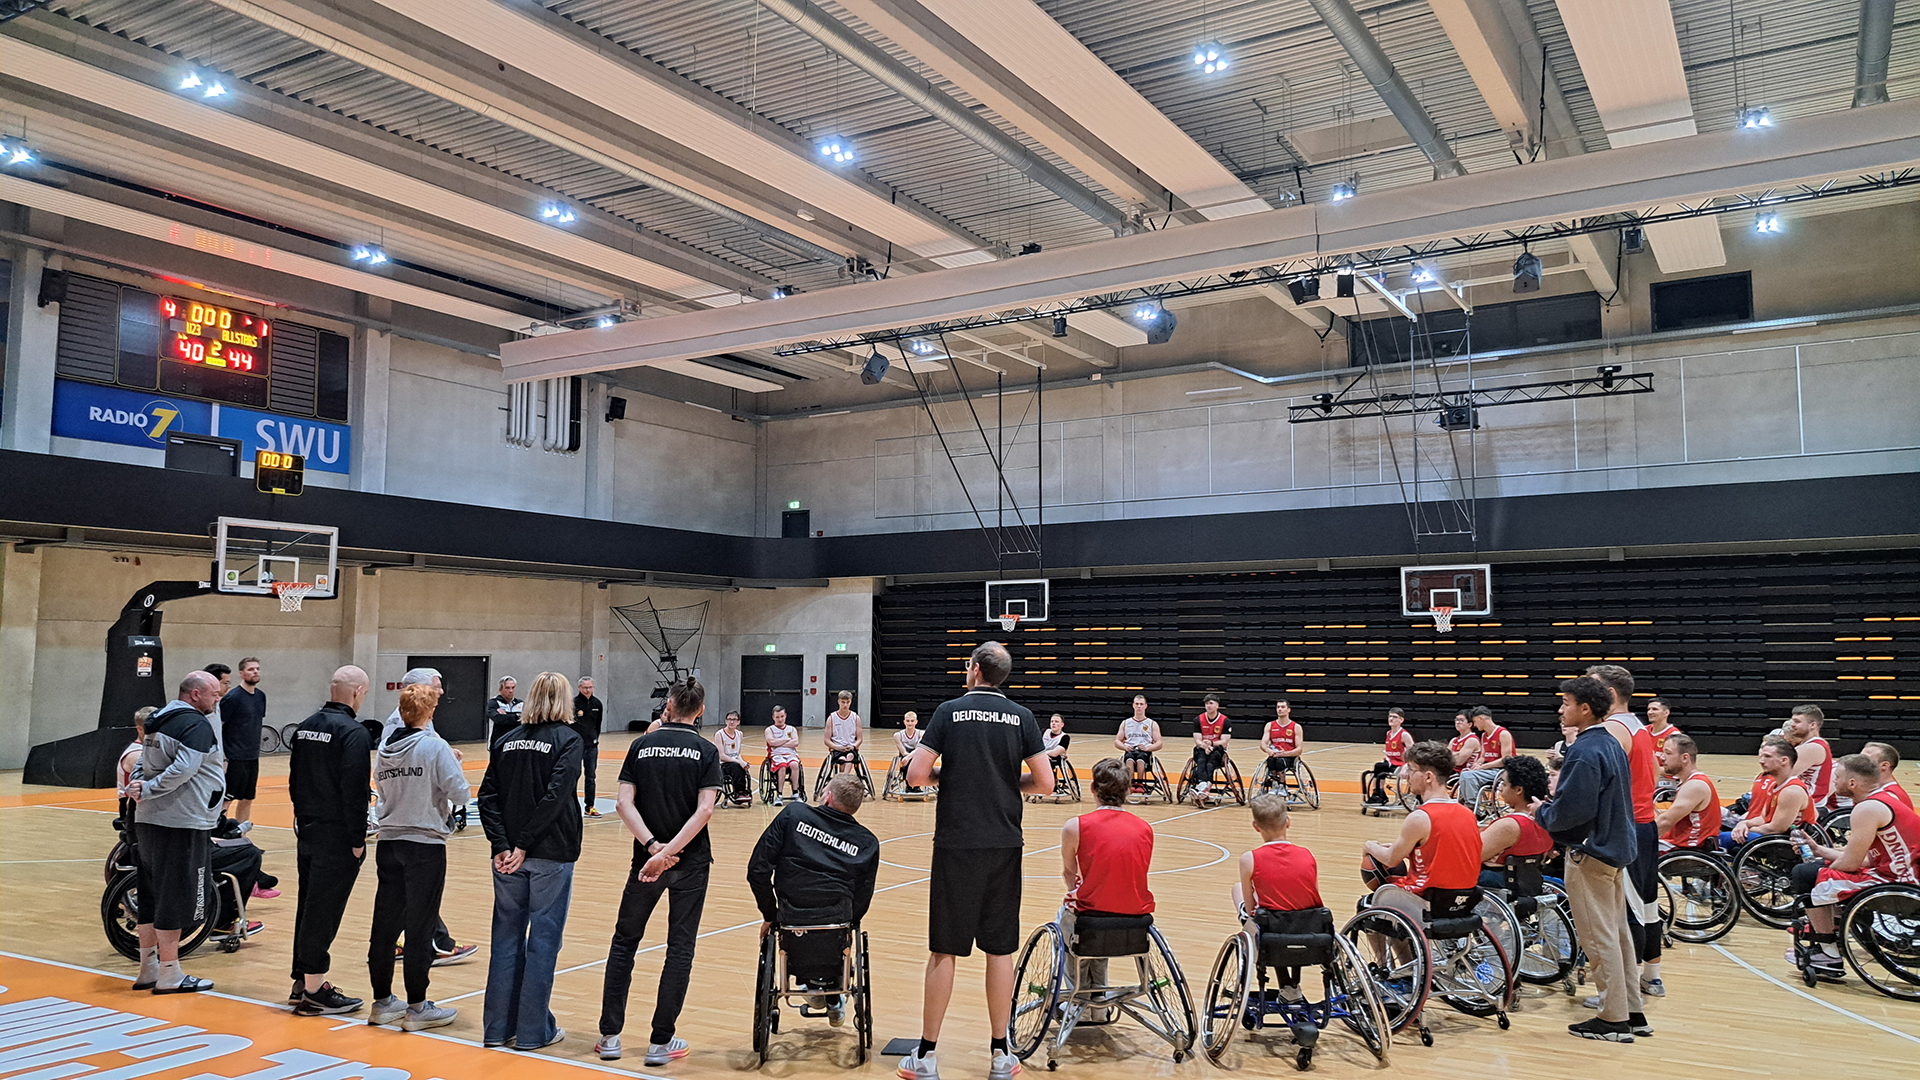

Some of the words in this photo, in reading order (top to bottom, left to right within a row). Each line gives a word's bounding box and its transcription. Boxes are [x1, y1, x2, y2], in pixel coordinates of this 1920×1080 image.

[164, 300, 177, 317] 4
[186, 321, 202, 336] U23
[222, 329, 258, 348] ALLSTARS
[180, 340, 204, 362] 40
[211, 341, 222, 356] 2
[229, 349, 253, 370] 44
[89, 406, 148, 428] RADIO
[149, 408, 179, 438] 7
[256, 419, 340, 464] SWU
[952, 709, 1021, 727] DEUTSCHLAND
[638, 746, 701, 761] DEUTSCHLAND
[1761, 778, 1770, 790] 5
[796, 821, 859, 857] DEUTSCHLAND
[1881, 832, 1916, 884] PALDING
